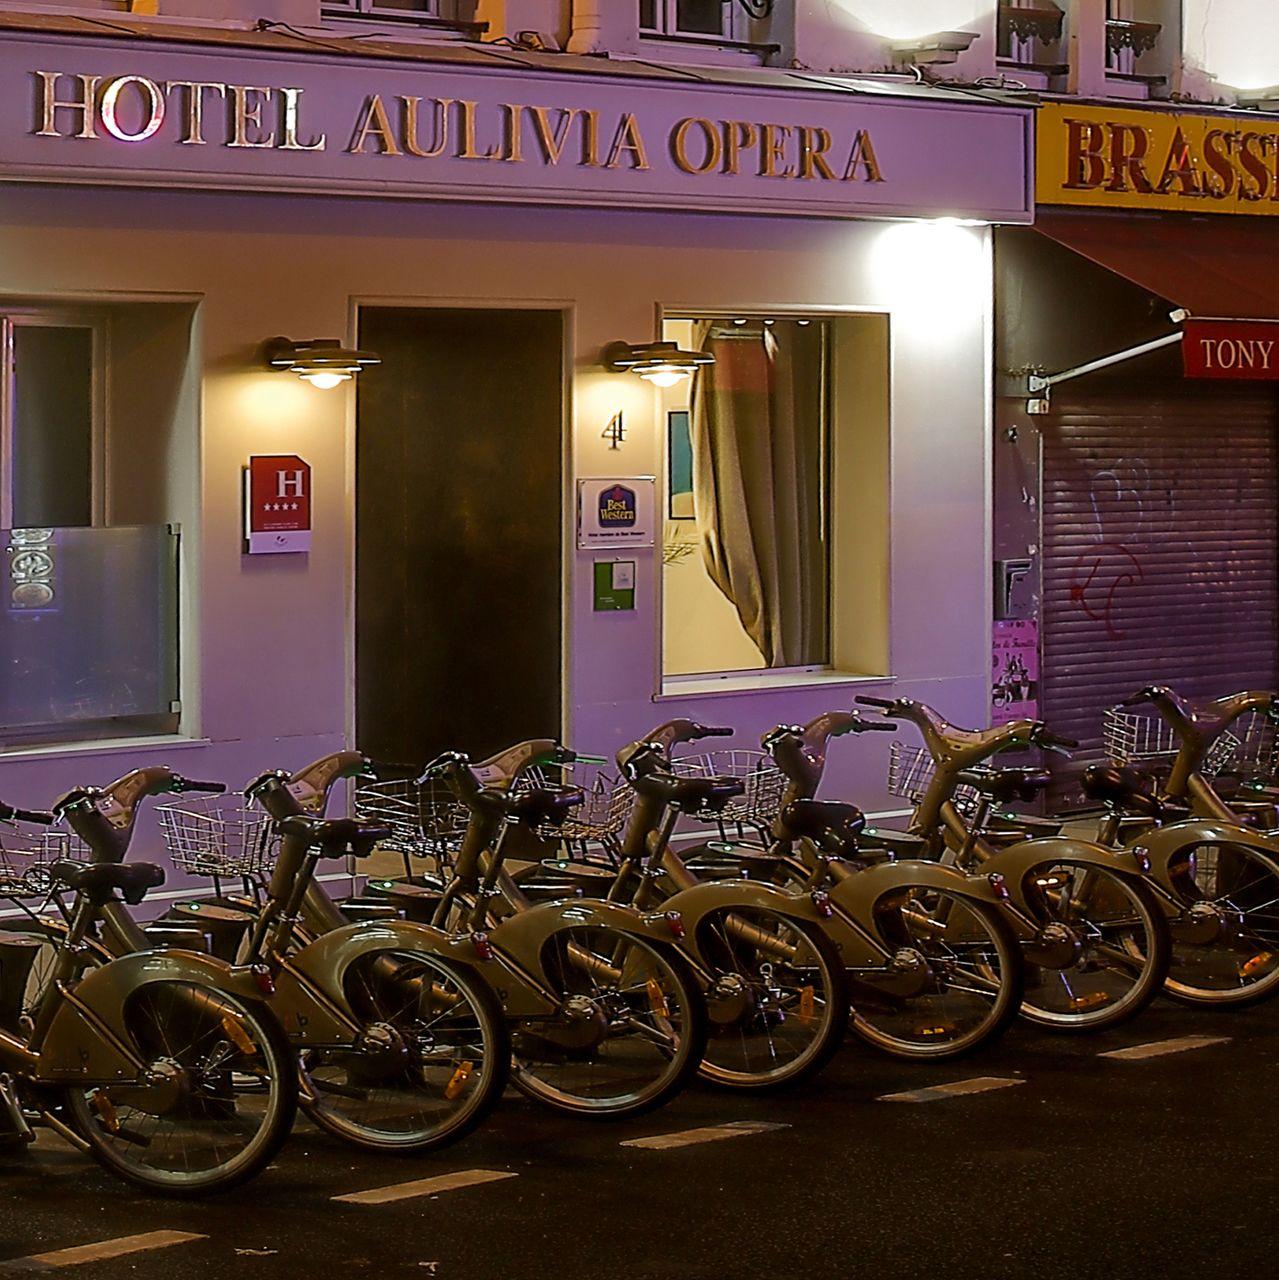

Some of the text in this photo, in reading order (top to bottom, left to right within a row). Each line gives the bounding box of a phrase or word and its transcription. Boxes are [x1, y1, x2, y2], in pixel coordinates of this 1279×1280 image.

[34, 69, 326, 151] HOTEL
[349, 94, 651, 171] AULIVIA
[669, 116, 886, 183] OPERA
[1200, 339, 1275, 370] TONY
[601, 409, 627, 450] 4
[276, 469, 304, 498] H
[601, 509, 634, 520] Western
[607, 499, 626, 511] Best
